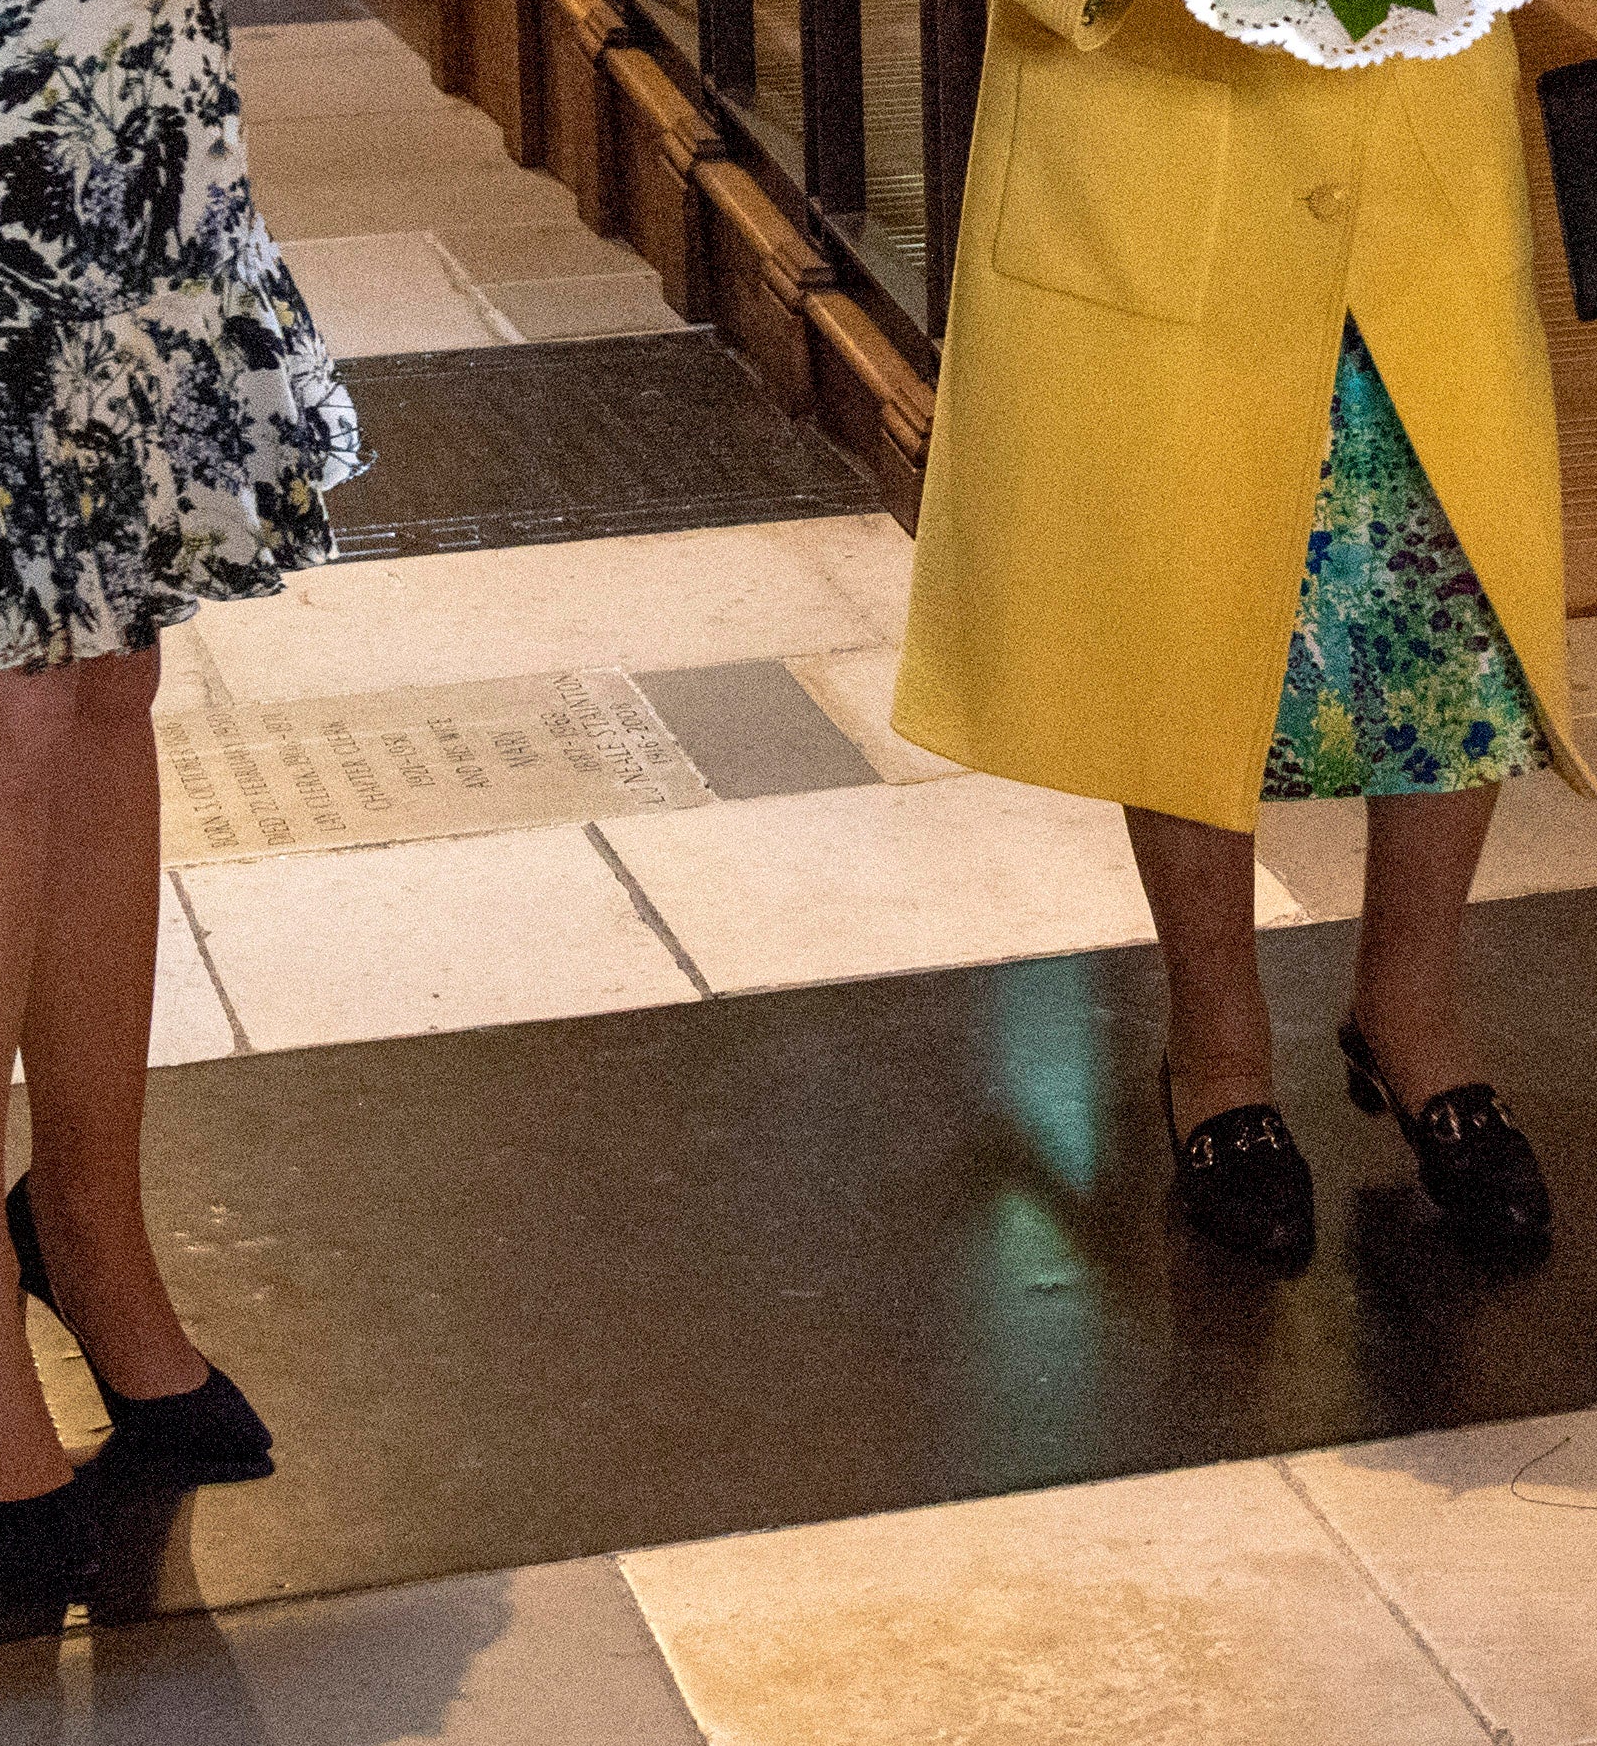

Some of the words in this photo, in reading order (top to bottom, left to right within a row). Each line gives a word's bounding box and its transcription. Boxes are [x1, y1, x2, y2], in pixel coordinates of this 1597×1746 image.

[551, 674, 617, 739] STAINTON
[321, 718, 361, 756] CLERK
[426, 716, 463, 744] WIFE
[490, 729, 540, 769] MARY
[222, 742, 269, 798] FEBRUARY
[442, 742, 476, 764] HIS
[596, 741, 653, 786] NEALE
[341, 757, 392, 812] CHAPTER
[454, 765, 493, 790] AND
[201, 814, 239, 849] BORN
[258, 816, 296, 846] DIED
